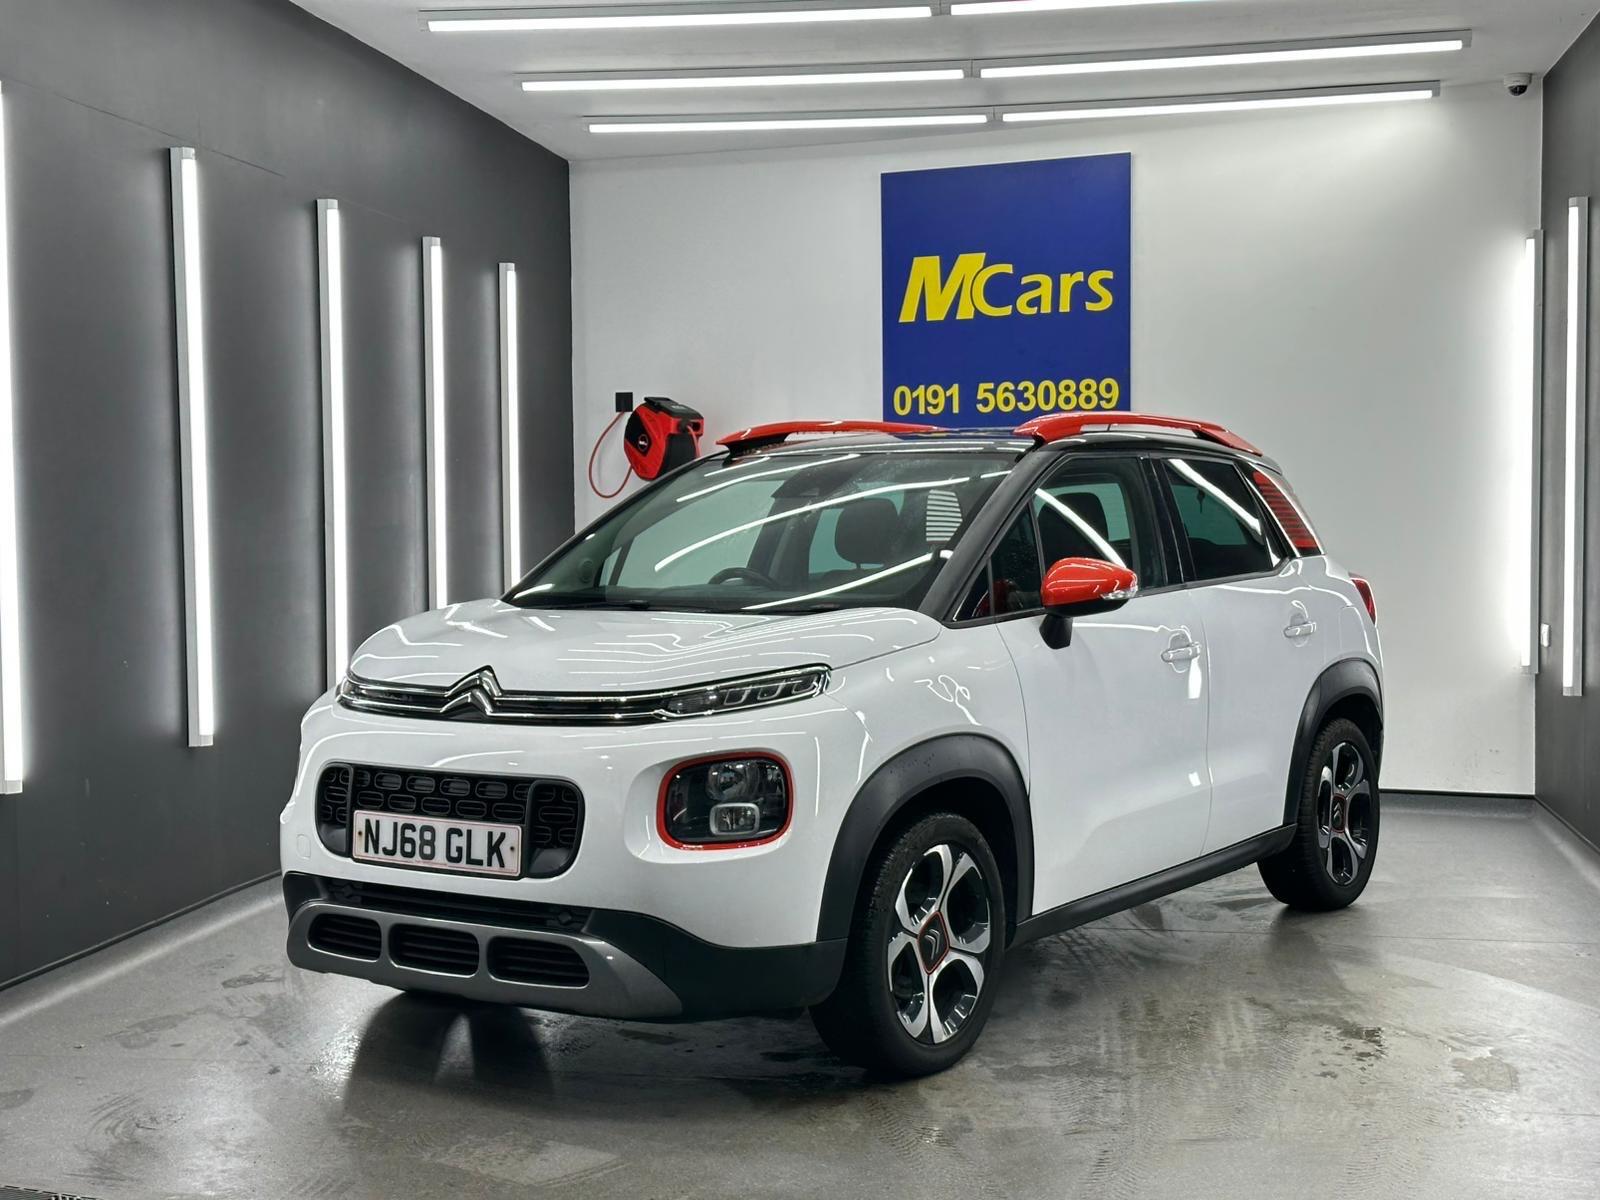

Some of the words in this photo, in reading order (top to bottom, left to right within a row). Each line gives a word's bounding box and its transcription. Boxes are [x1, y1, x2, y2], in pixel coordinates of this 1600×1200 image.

[893, 383, 959, 416] 0191
[976, 378, 1119, 413] 5630889
[364, 818, 436, 860] NJ68
[445, 827, 506, 868] GLK
